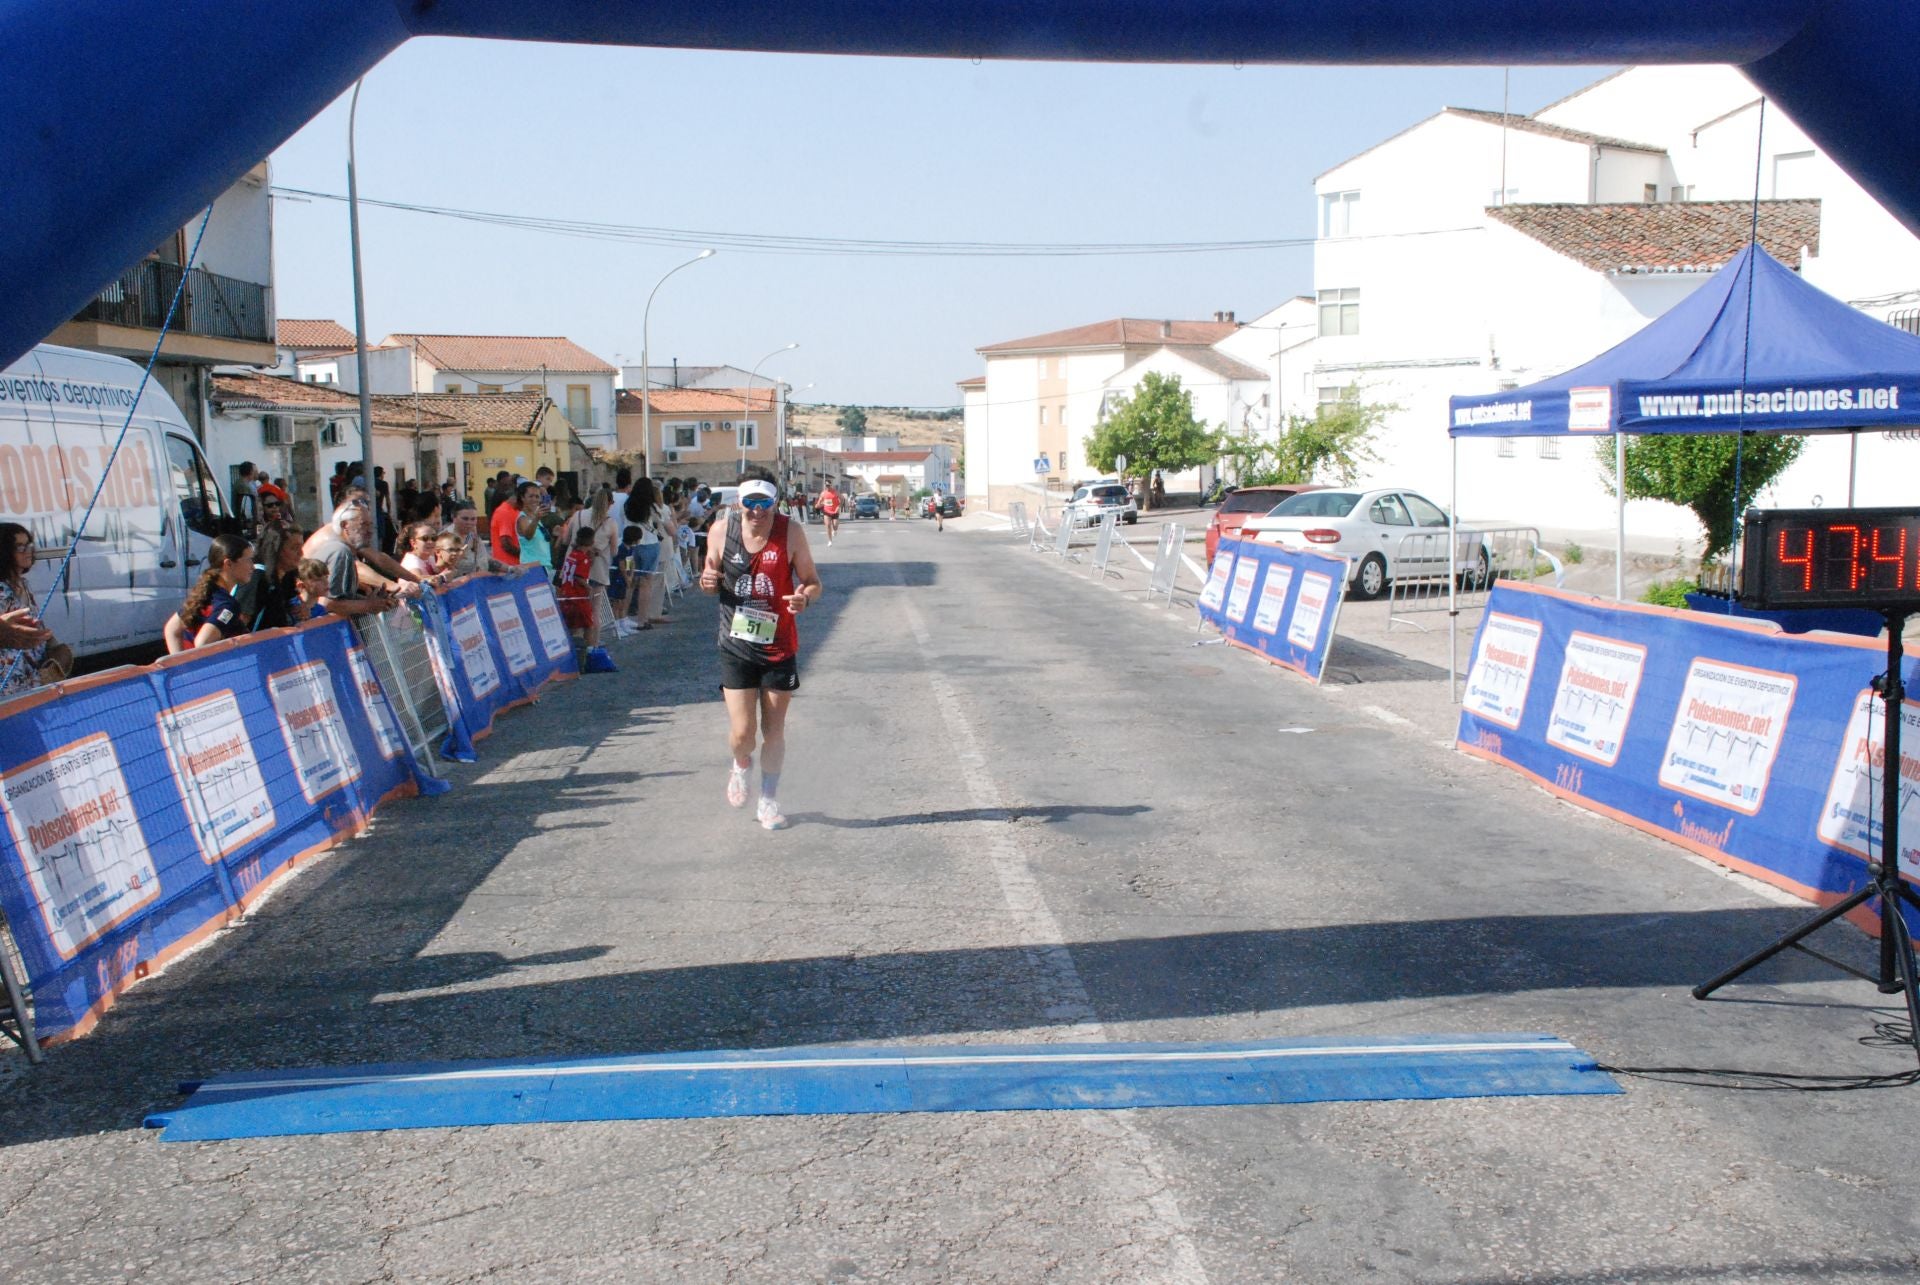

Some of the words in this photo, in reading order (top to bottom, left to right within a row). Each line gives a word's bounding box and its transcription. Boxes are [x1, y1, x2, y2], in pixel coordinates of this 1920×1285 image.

[0, 374, 60, 402] eventos
[63, 378, 136, 410] deportivos
[1638, 386, 1899, 418] www.pulsaciones.net
[0, 440, 158, 515] onesnet
[1777, 524, 1920, 592] 47:4
[746, 620, 762, 635] 51
[1686, 697, 1772, 738] Pulsaciones.net
[27, 785, 122, 854] Pulsaciones.net
